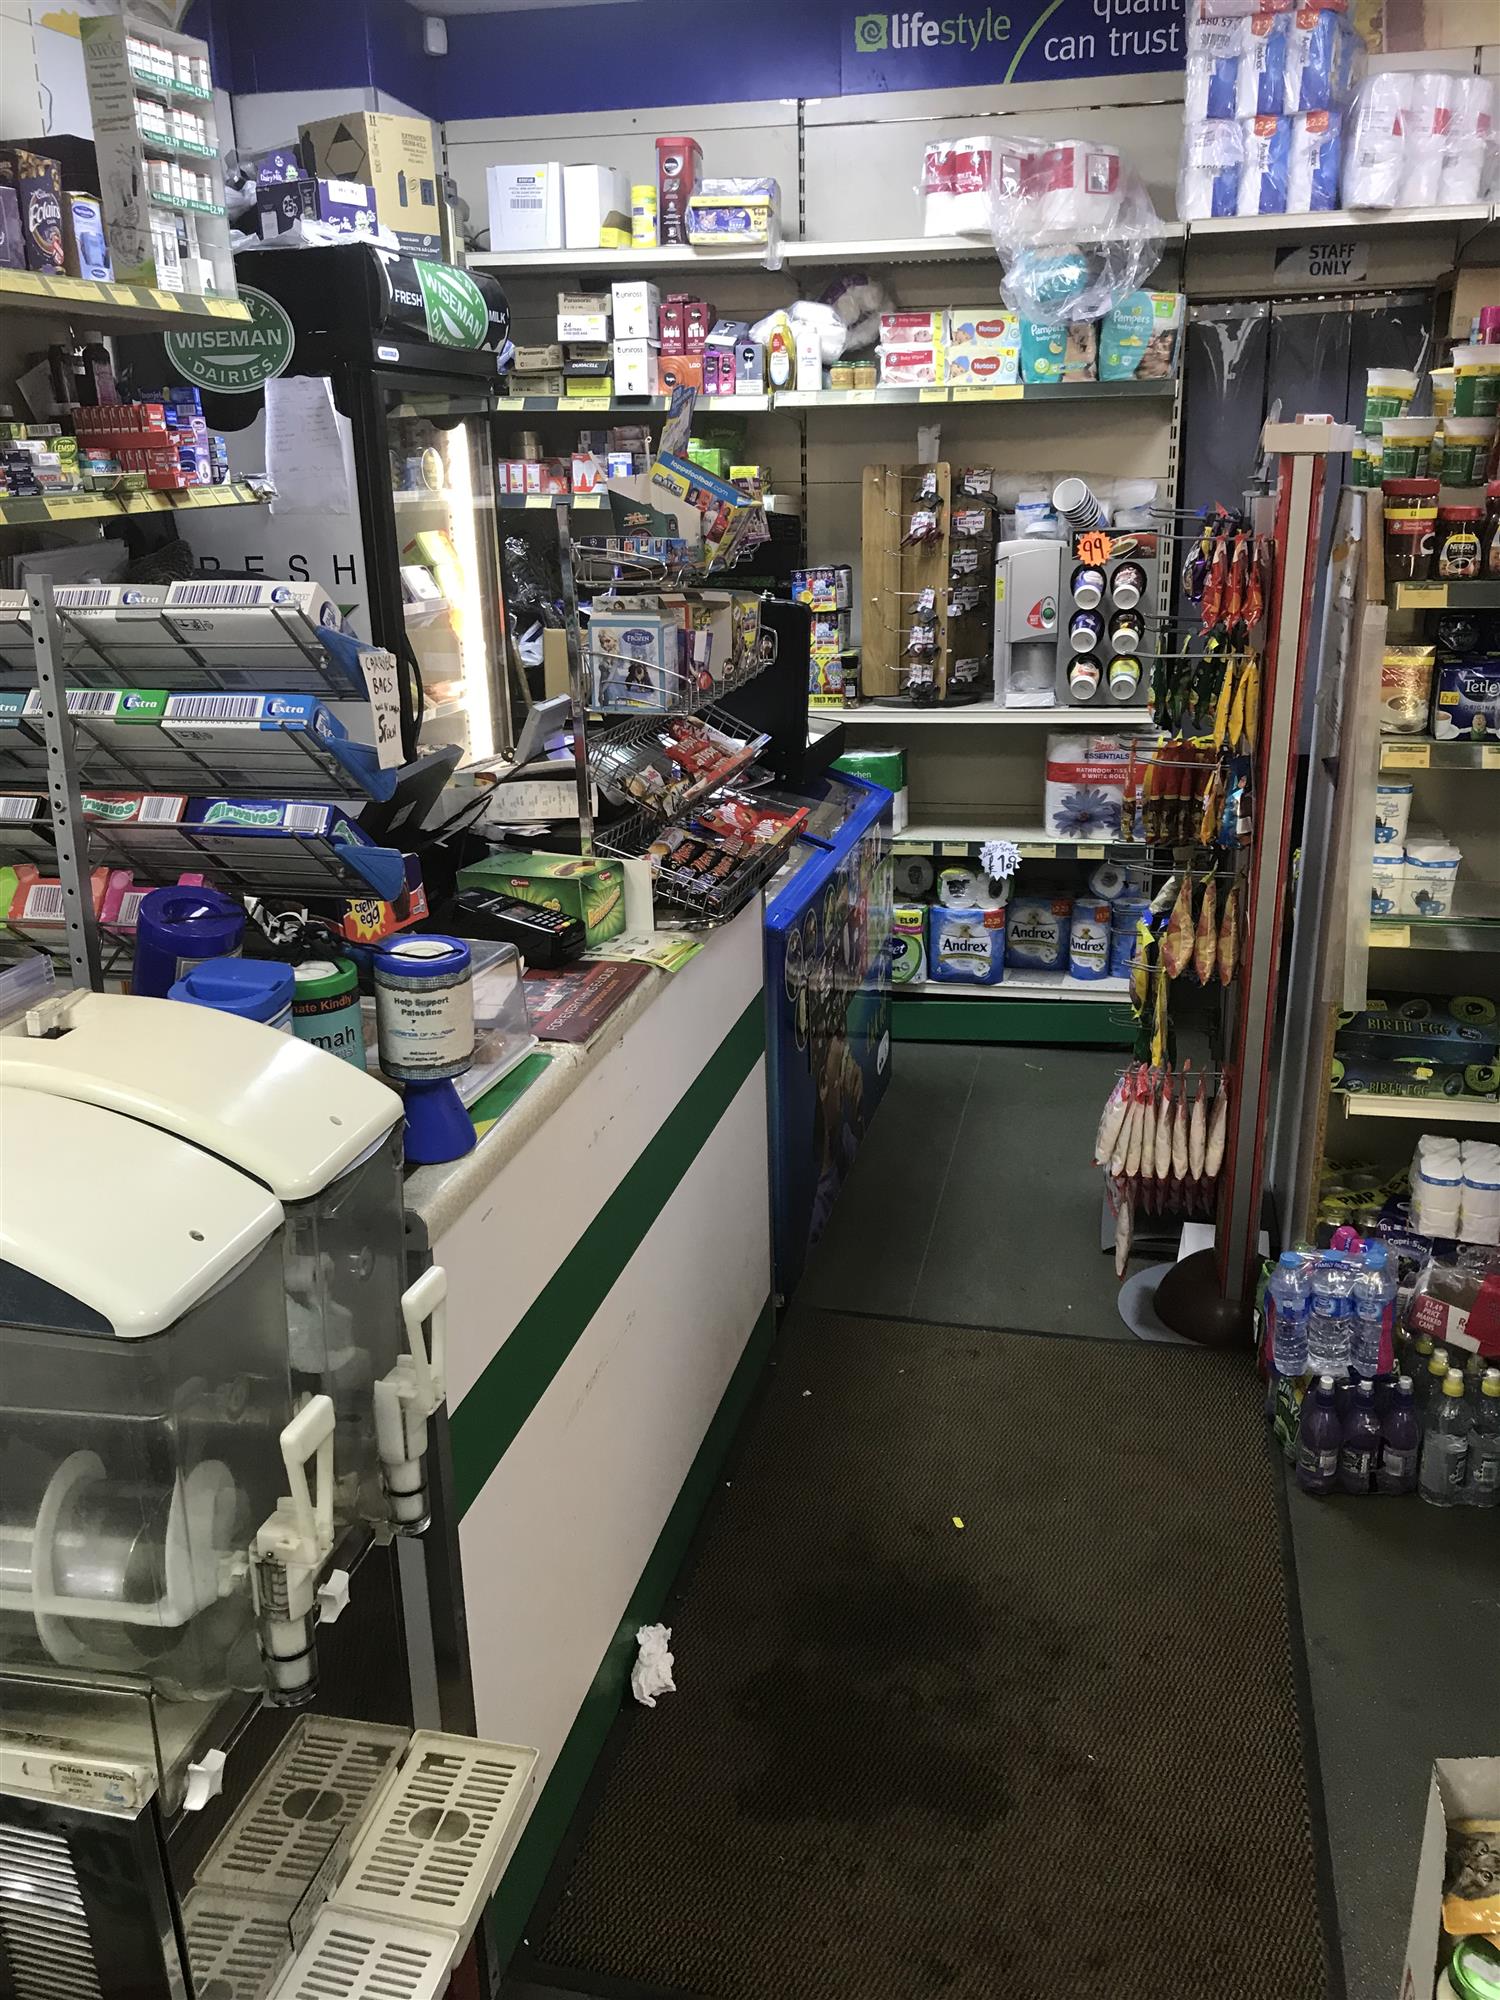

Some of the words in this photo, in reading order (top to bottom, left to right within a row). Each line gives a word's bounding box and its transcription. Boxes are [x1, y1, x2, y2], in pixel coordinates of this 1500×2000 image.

[892, 8, 1011, 51] lifestyle
[1044, 35, 1095, 61] can
[1109, 23, 1180, 56] trust
[157, 76, 172, 88] £2.99
[195, 87, 209, 100] £2.99
[165, 135, 180, 147] £2.99
[202, 145, 217, 157] £2.99
[173, 195, 188, 208] £2.99
[209, 204, 224, 216] £2.99
[1308, 243, 1356, 259] STAFF
[1309, 260, 1351, 276] ONLY
[394, 289, 423, 307] FRESH
[422, 268, 483, 340] WISEMAN
[489, 310, 506, 324] MILK
[1113, 310, 1150, 324] Pampers
[1031, 324, 1065, 336] Pampers
[176, 328, 282, 349] WISEMAN
[193, 358, 274, 384] DAIRIES
[1082, 537, 1105, 562] 99
[199, 554, 357, 585] RESH
[126, 592, 160, 605] Extra
[626, 635, 650, 643] FROZEN
[0, 703, 17, 712] tra
[127, 697, 158, 709] Extra
[271, 701, 305, 714] Extra
[1463, 703, 1496, 711] ORIGINA
[1084, 752, 1130, 760] ESSENTIALS
[204, 802, 281, 824] Airwaves
[360, 904, 381, 928] egg
[1010, 925, 1055, 940] Andrex
[943, 938, 988, 952] Andrex
[1071, 937, 1105, 952] Andrex
[294, 1000, 317, 1014] nate
[320, 995, 352, 1011] Kindly
[394, 997, 413, 1008] Help
[415, 996, 449, 1008] Support
[401, 1008, 443, 1017] Palestine
[1367, 1018, 1412, 1033] BIRTH
[1419, 1023, 1450, 1035] EGG
[1368, 1081, 1401, 1095] BIRTH
[1423, 1306, 1441, 1319] PRICE
[1425, 1300, 1444, 1312] £1.49
[1416, 1311, 1442, 1327] MARKED
[1418, 1320, 1435, 1332] CANS
[93, 1771, 126, 1782] SERVICE
